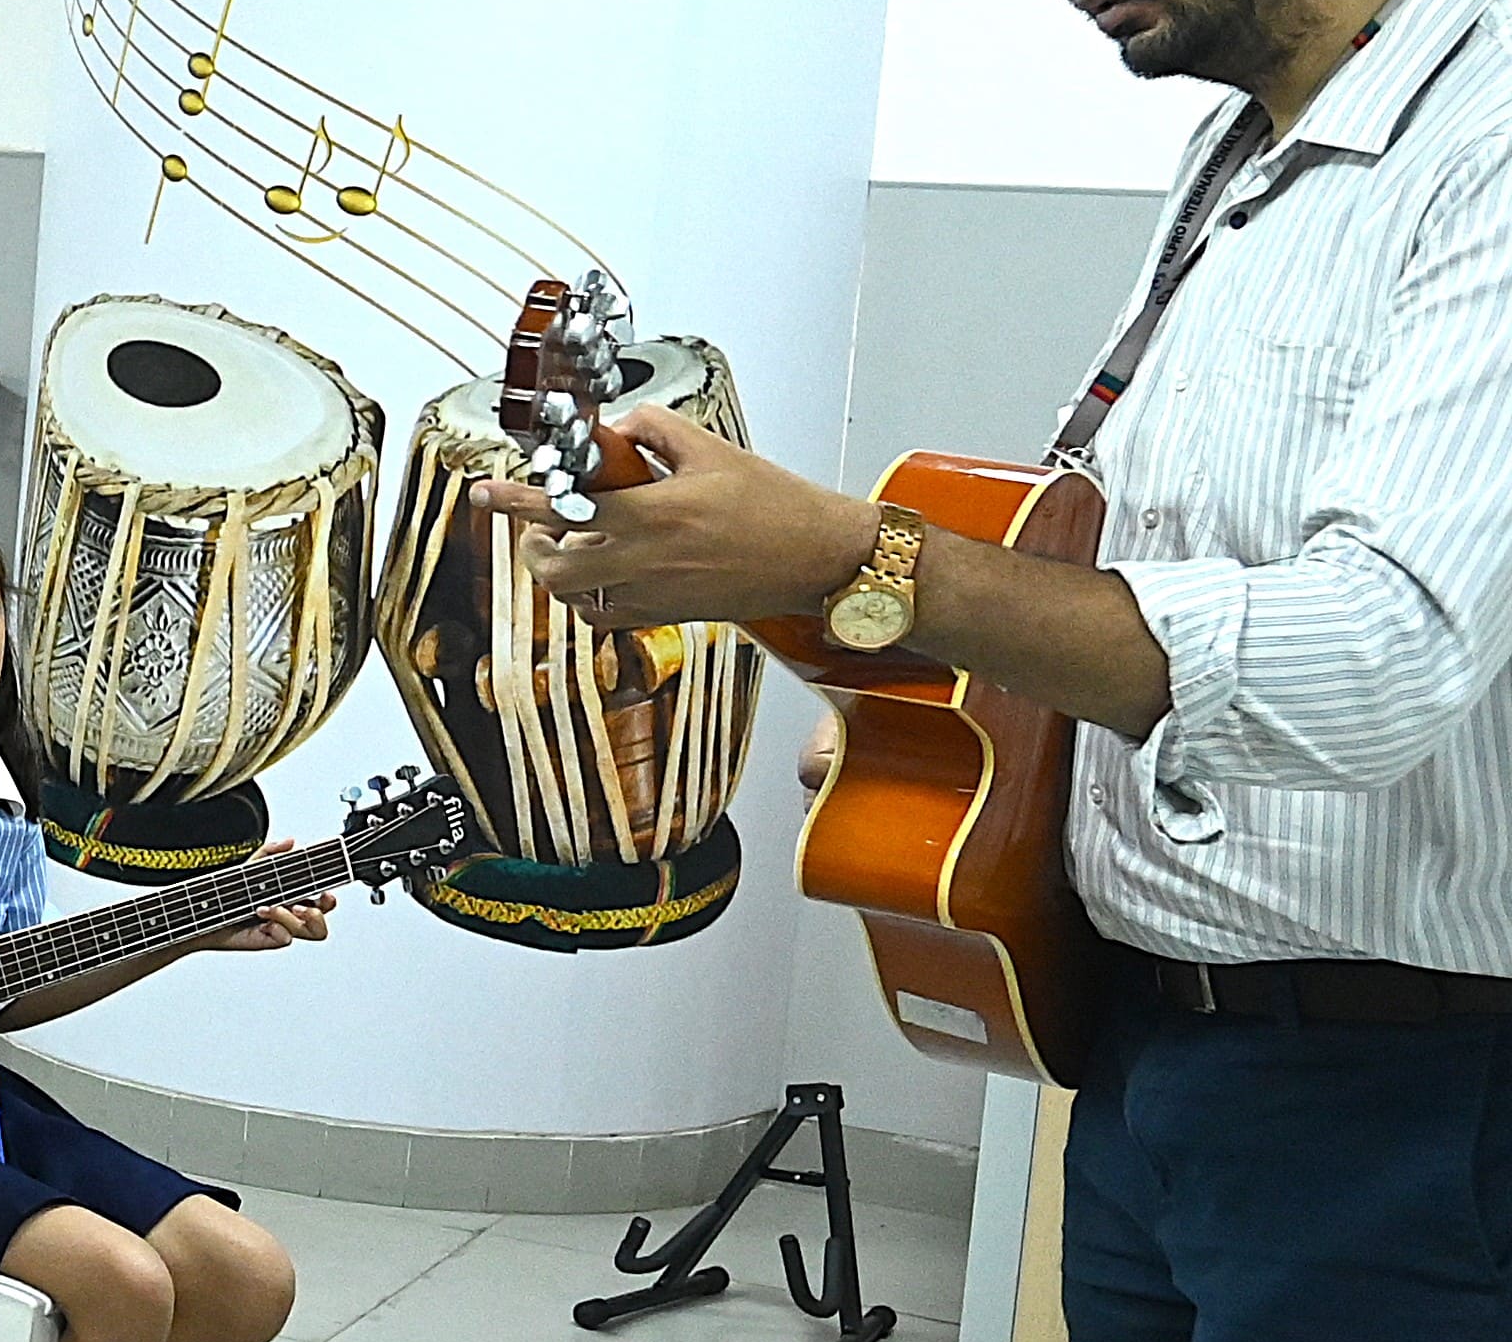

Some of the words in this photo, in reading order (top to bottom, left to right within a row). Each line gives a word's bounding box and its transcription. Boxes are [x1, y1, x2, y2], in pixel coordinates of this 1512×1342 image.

[1162, 224, 1186, 264] ELPRO
[1180, 130, 1244, 223] INTERNATIONAL
[443, 796, 465, 844] filia
